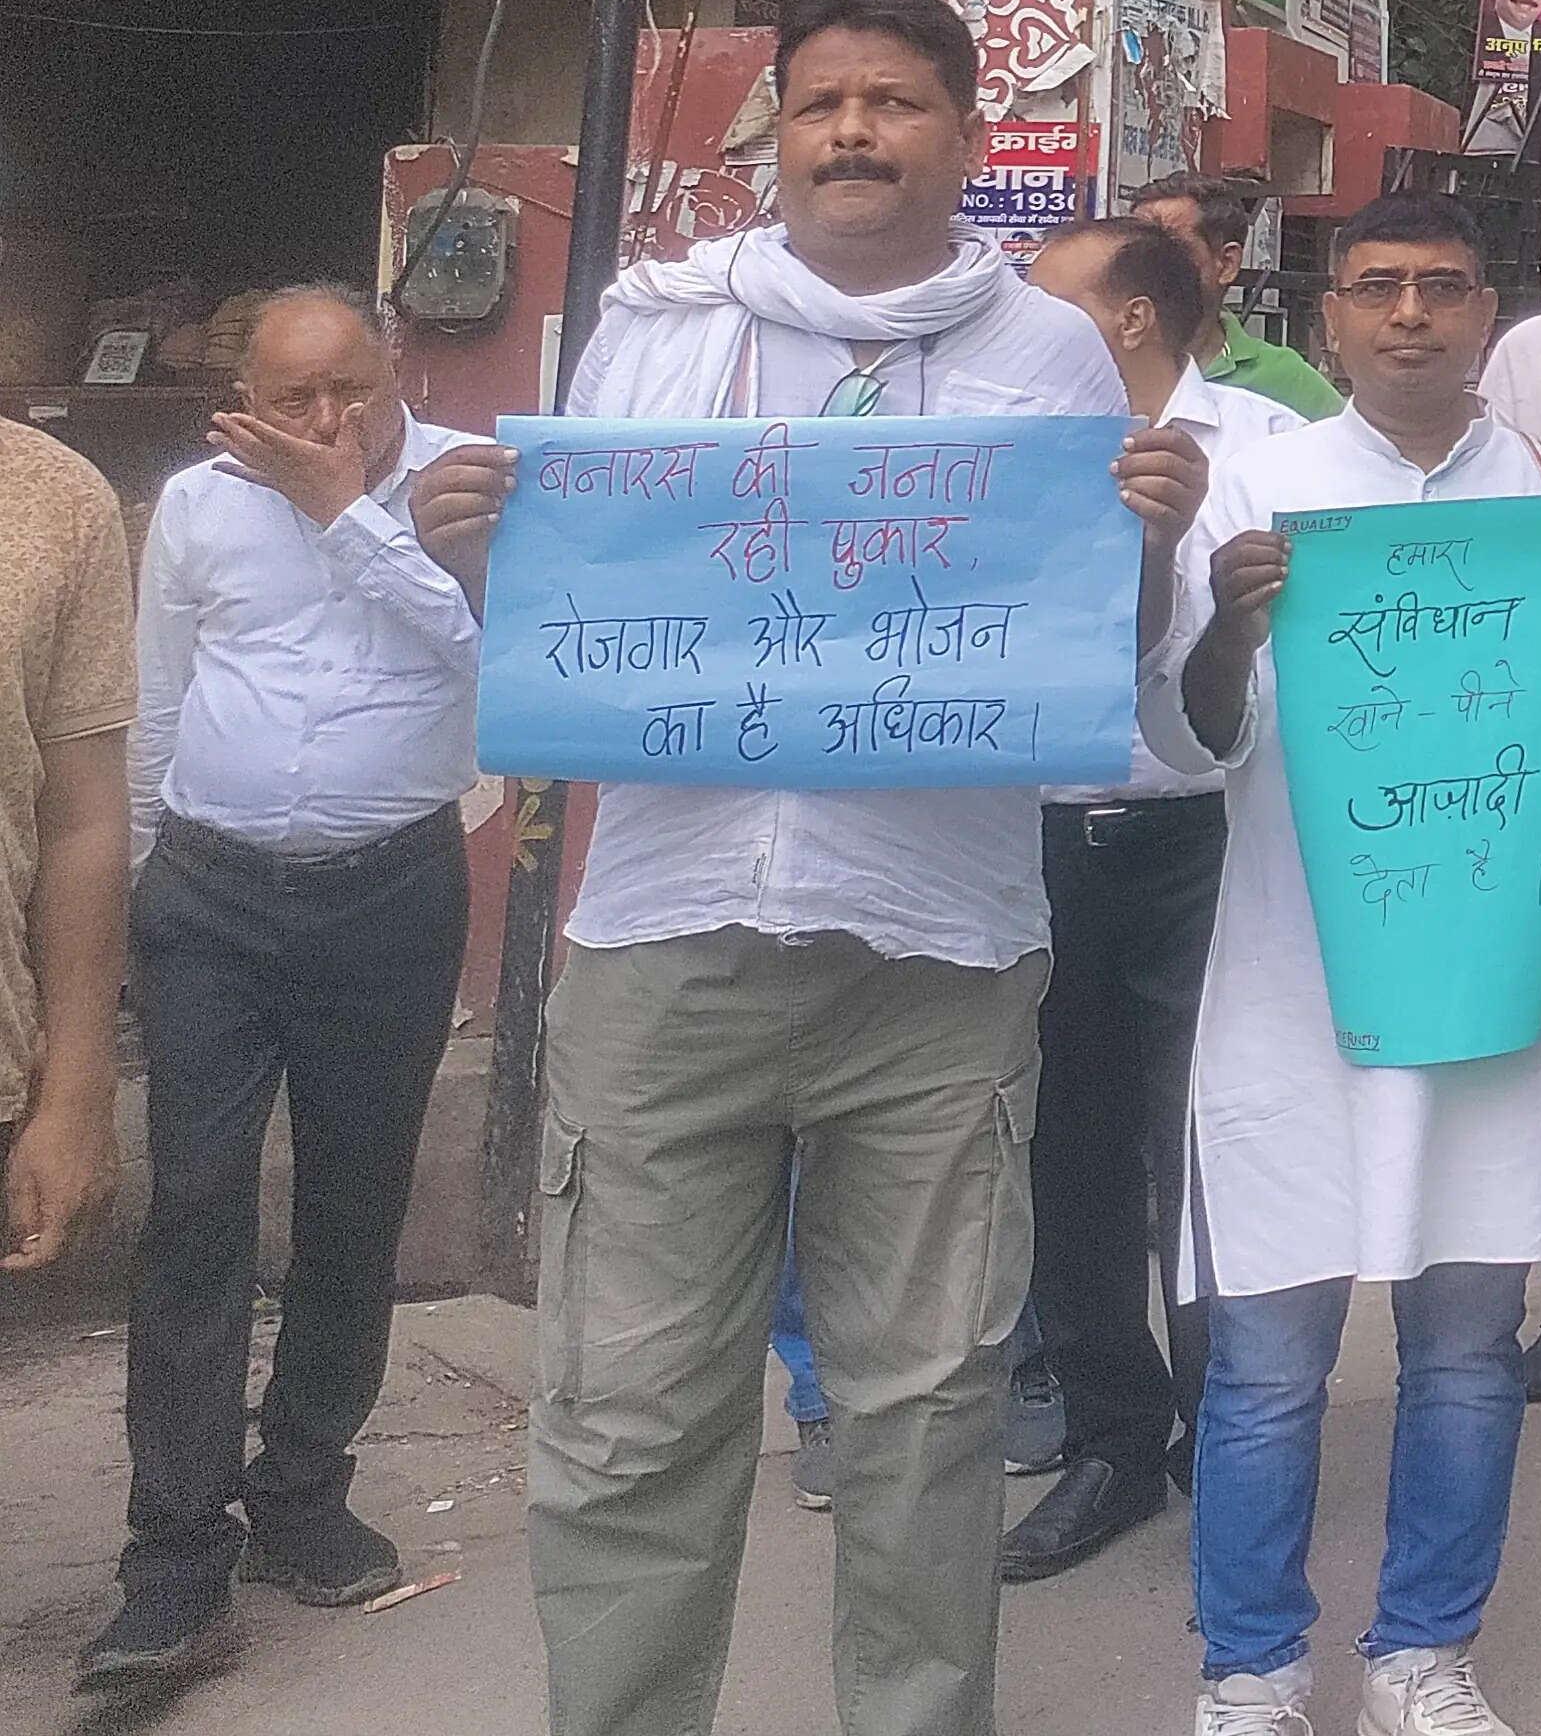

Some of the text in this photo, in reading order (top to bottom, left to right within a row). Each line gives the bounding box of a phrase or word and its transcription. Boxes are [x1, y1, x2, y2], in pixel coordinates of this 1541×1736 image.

[1485, 37, 1529, 57] अनूप
[962, 164, 1069, 191] धान
[539, 422, 1014, 503] बनारस की जनता
[698, 497, 808, 581] रही
[1280, 515, 1353, 535] EQUALITY
[1386, 538, 1474, 591] हमारा
[540, 575, 1029, 679] रोजगार और भोजन
[1328, 592, 1525, 678] संविधान
[641, 700, 716, 758] का
[735, 681, 782, 762] है
[818, 674, 1006, 758] अधिकार
[1350, 854, 1440, 927] देता
[1466, 839, 1500, 892] है
